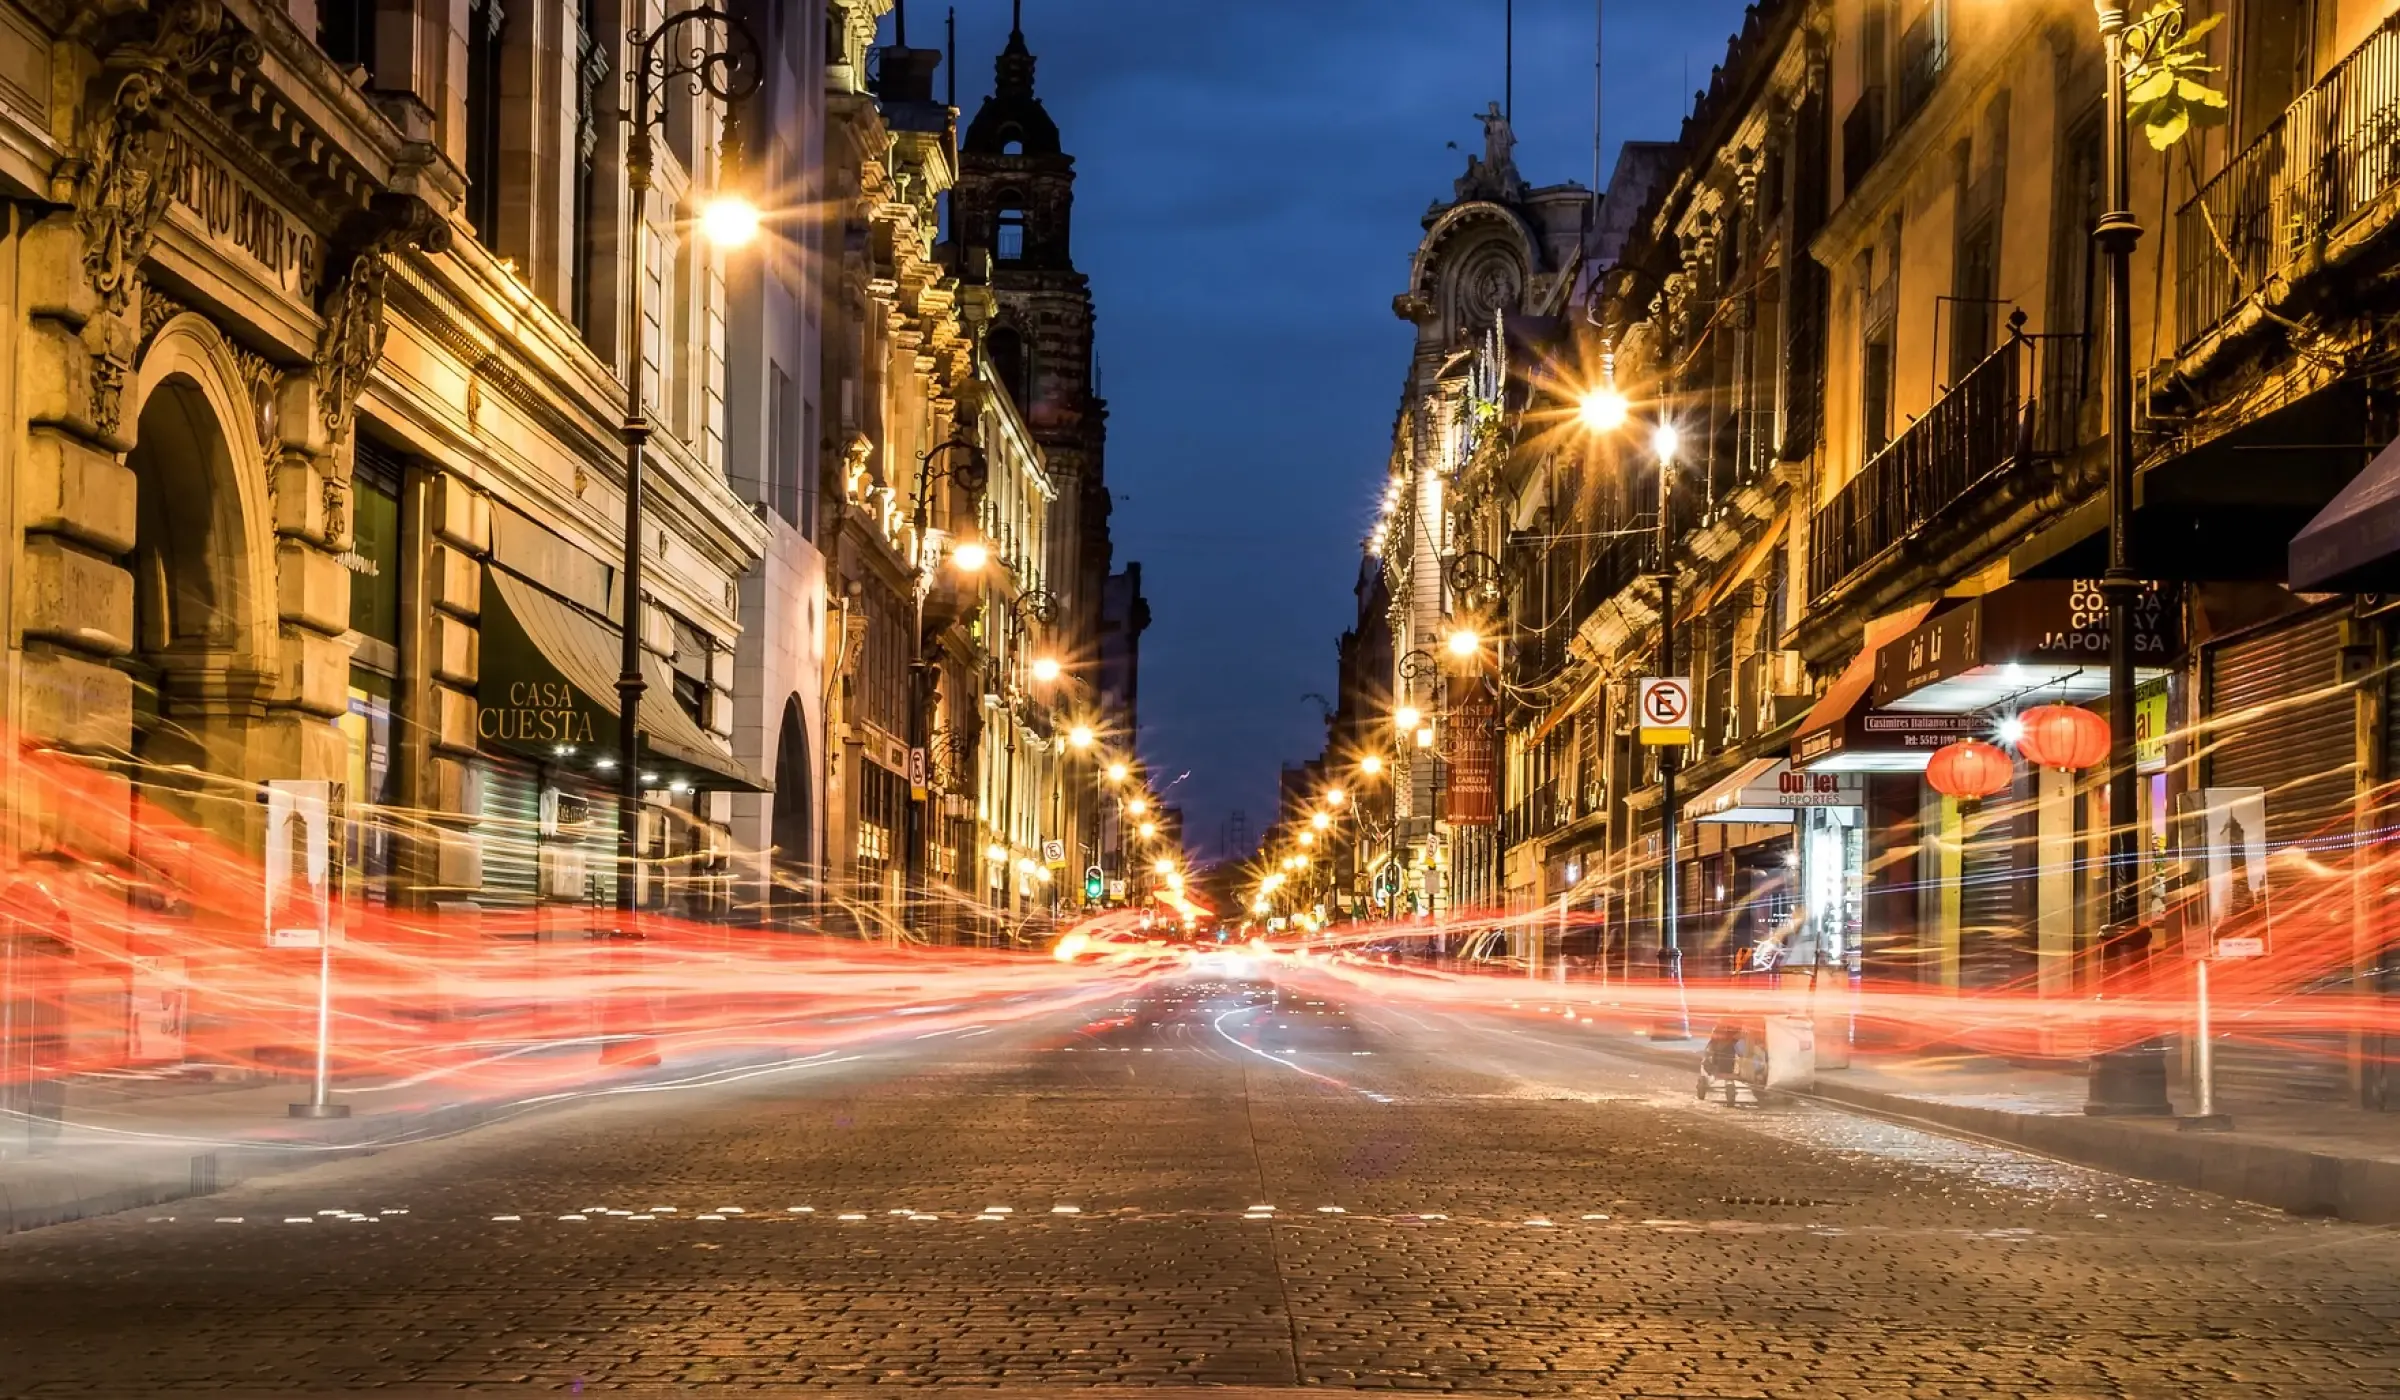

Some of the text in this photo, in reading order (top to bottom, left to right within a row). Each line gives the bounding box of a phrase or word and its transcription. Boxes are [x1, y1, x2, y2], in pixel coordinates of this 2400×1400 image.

[287, 226, 297, 270] Y
[2069, 593, 2161, 611] CODA
[2071, 612, 2143, 629] CHIA
[2039, 632, 2164, 652] JAPONSA
[510, 681, 573, 708] CASA
[478, 707, 595, 742] CUESTA
[1869, 718, 1909, 728] Casimires
[1911, 718, 1948, 728] Italianos
[1949, 719, 1956, 727] e
[1455, 775, 1487, 784] CARLOS
[1779, 794, 1840, 806] DEPORTES
